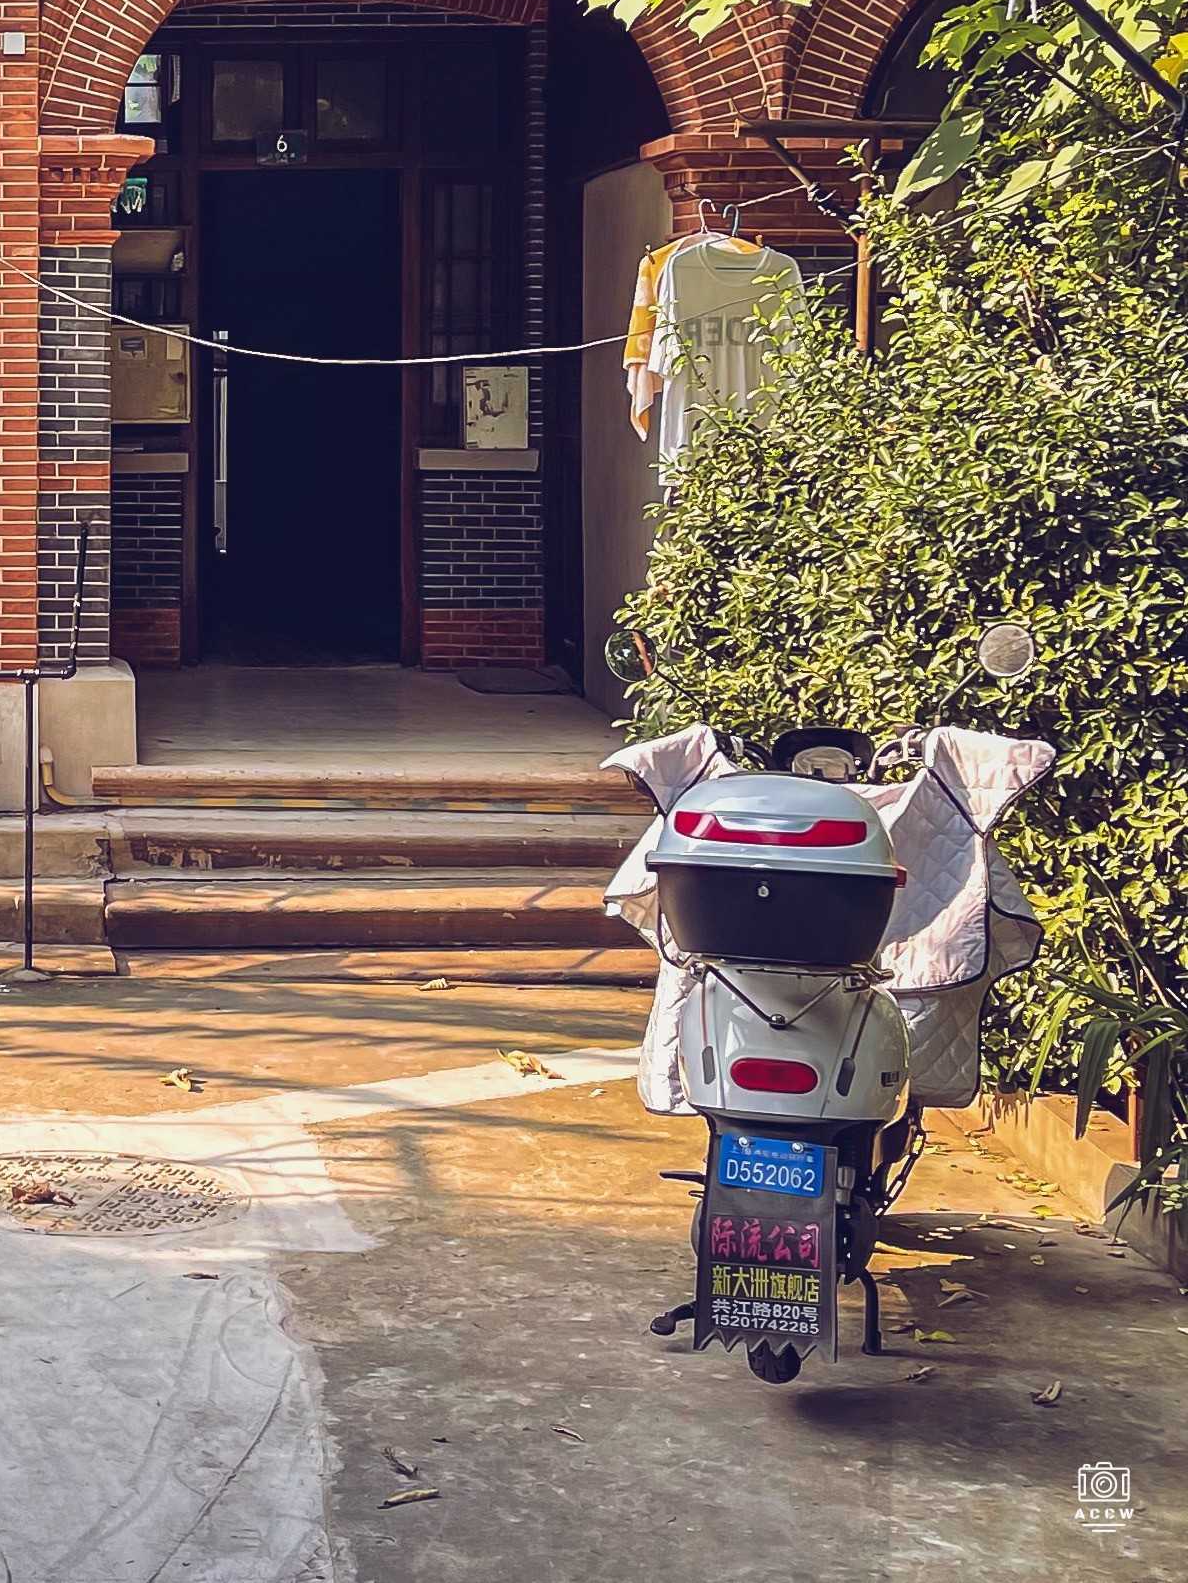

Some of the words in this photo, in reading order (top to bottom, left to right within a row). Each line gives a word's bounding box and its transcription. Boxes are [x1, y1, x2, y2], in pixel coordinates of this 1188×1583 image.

[276, 134, 288, 153] 6
[726, 1159, 816, 1192] D552062
[712, 1264, 820, 1303] 新大洲旗舰店
[712, 1298, 819, 1322] 共江路820号
[712, 1314, 820, 1334] 15201742285
